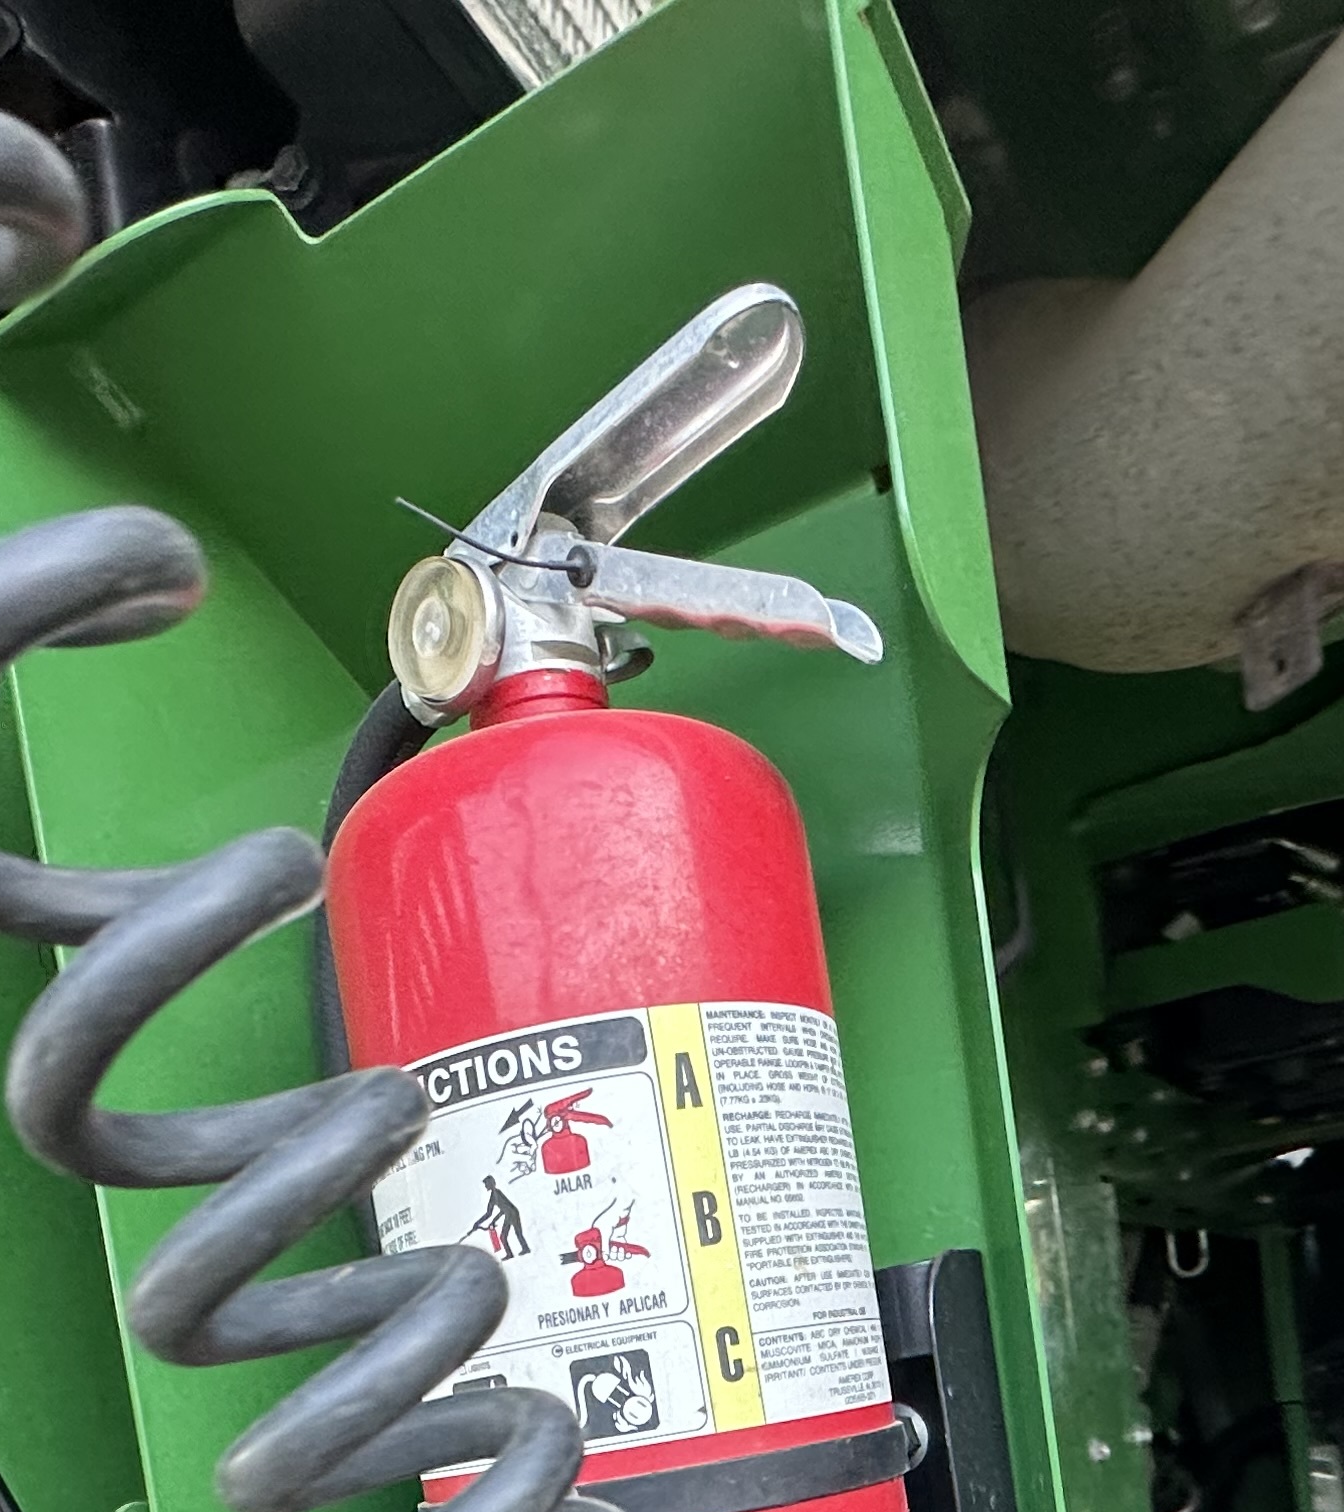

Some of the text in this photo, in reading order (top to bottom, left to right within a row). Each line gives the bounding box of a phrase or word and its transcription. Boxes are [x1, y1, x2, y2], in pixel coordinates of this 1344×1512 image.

[708, 1022, 752, 1031] FREQUENT
[714, 1058, 756, 1068] OPERABLE
[716, 1072, 725, 1081] IN
[768, 1070, 793, 1079] GROSS
[718, 1083, 764, 1094] (INCLUDING
[767, 1082, 786, 1091] HOSE
[789, 1082, 801, 1091] AND
[746, 1123, 777, 1132] PARTIAL
[726, 1137, 738, 1146] TO
[763, 1134, 784, 1143] HAVE
[728, 1149, 739, 1158] LB
[781, 1146, 791, 1155] OF
[730, 1158, 786, 1170] PRESSURIZED
[732, 1173, 744, 1183] BY
[755, 1171, 765, 1180] AN
[775, 1169, 818, 1179] AUTHORIZED
[554, 1174, 592, 1195] JALAR
[735, 1182, 791, 1195] (RECHARGER)
[736, 1195, 768, 1206] MANUAL
[675, 1052, 744, 1383] A B C
[739, 1214, 751, 1223] TO
[757, 1212, 768, 1221] BE
[741, 1225, 772, 1235] TESTED
[783, 1220, 827, 1231] ACCORDANCE
[743, 1235, 782, 1247] SUPPLIED
[785, 1233, 803, 1243] WITH
[745, 1248, 764, 1259] FIRE
[767, 1244, 812, 1257] PROTECTION
[794, 1272, 816, 1282] AFTER
[751, 1287, 793, 1300] SURFACES
[795, 1282, 833, 1294] CONTACTED
[538, 1291, 667, 1329] PRESIONAR Y APLICAR
[811, 1329, 825, 1340] ABC
[565, 1340, 610, 1355] ELECTRICAL
[611, 1331, 658, 1348] EQUIPMENT
[760, 1343, 812, 1359] MUSCOVITE
[820, 1349, 850, 1362] SULFATE
[810, 1362, 847, 1376] CONTENTS
